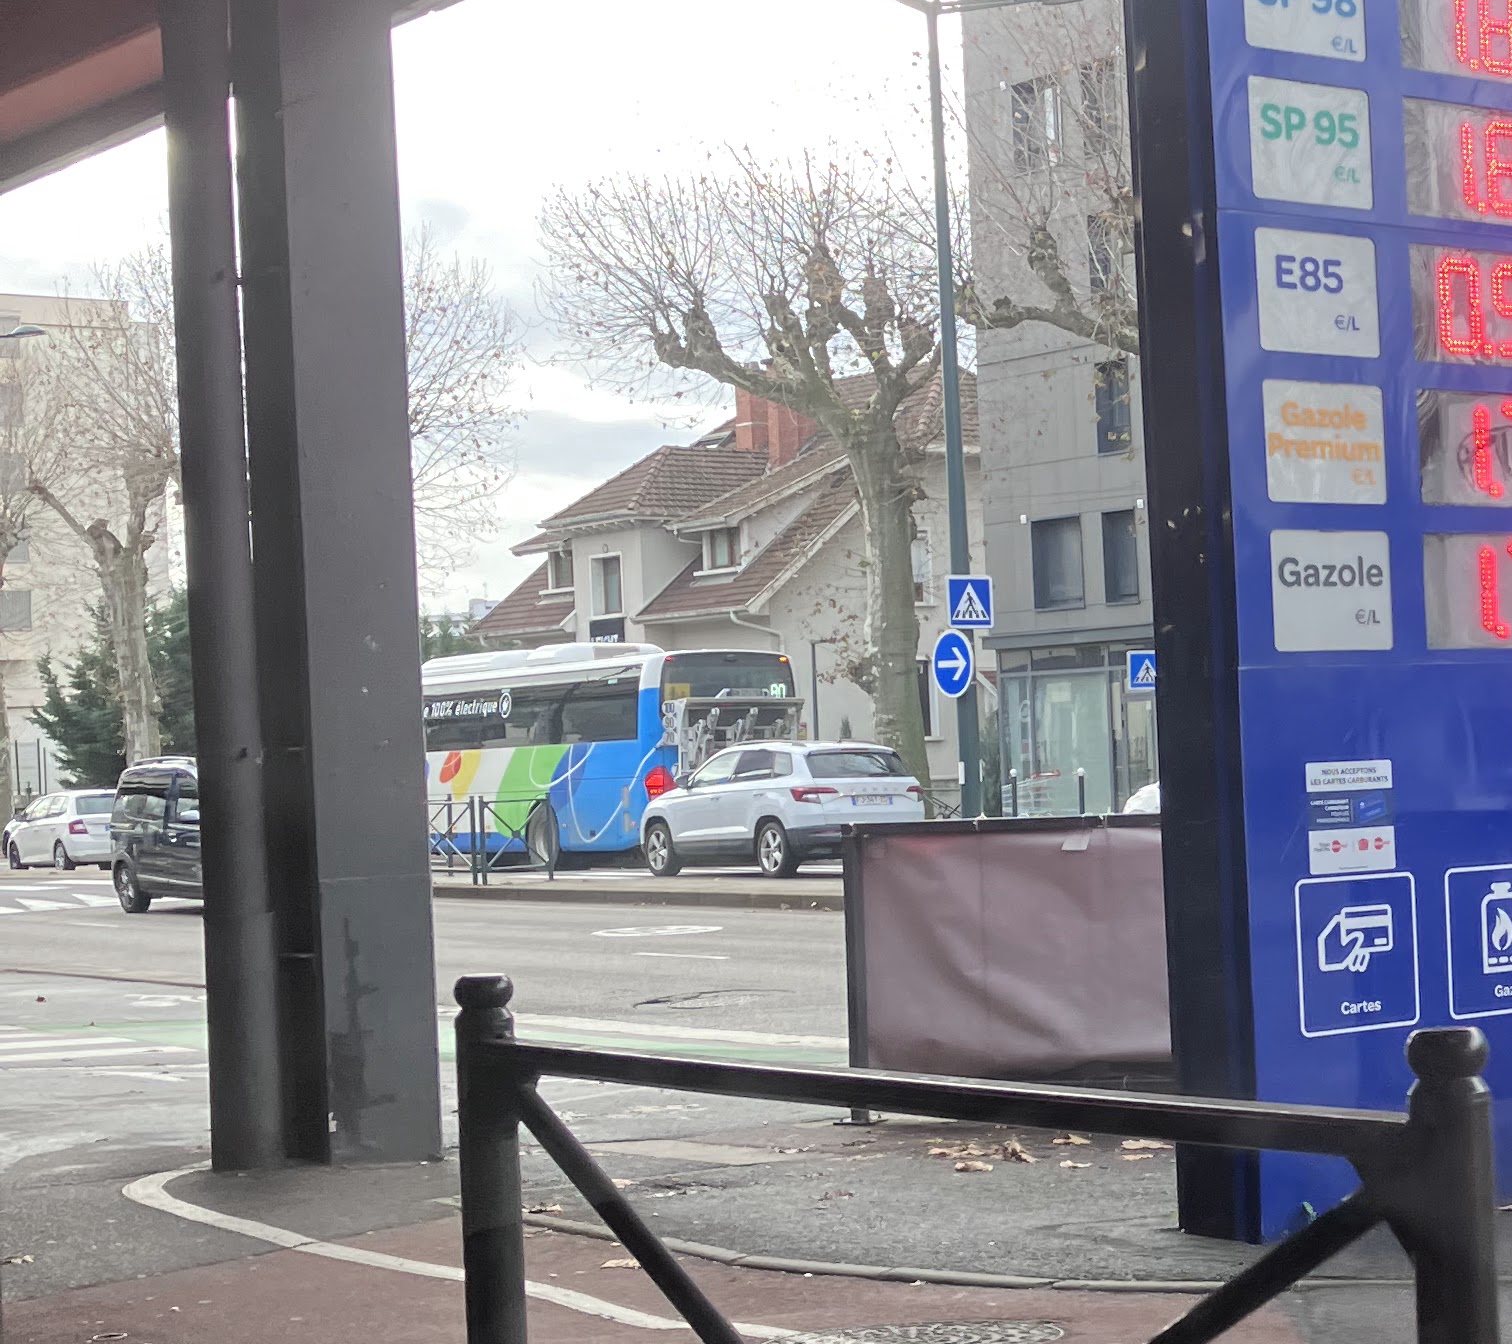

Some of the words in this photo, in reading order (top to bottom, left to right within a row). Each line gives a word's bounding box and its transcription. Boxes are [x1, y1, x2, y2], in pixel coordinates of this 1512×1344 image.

[1331, 36, 1357, 54] €/L
[1261, 103, 1306, 141] SP
[1314, 110, 1359, 149] 95
[1275, 254, 1344, 294] E85
[1334, 314, 1360, 331] €/L
[1281, 401, 1367, 431] Gazole
[1267, 432, 1382, 462] Premium
[1278, 555, 1383, 587] Gazole
[1355, 609, 1380, 625] €/L
[431, 700, 454, 716] 100%
[455, 698, 498, 717] électrique
[1340, 1000, 1382, 1015] Cartes
